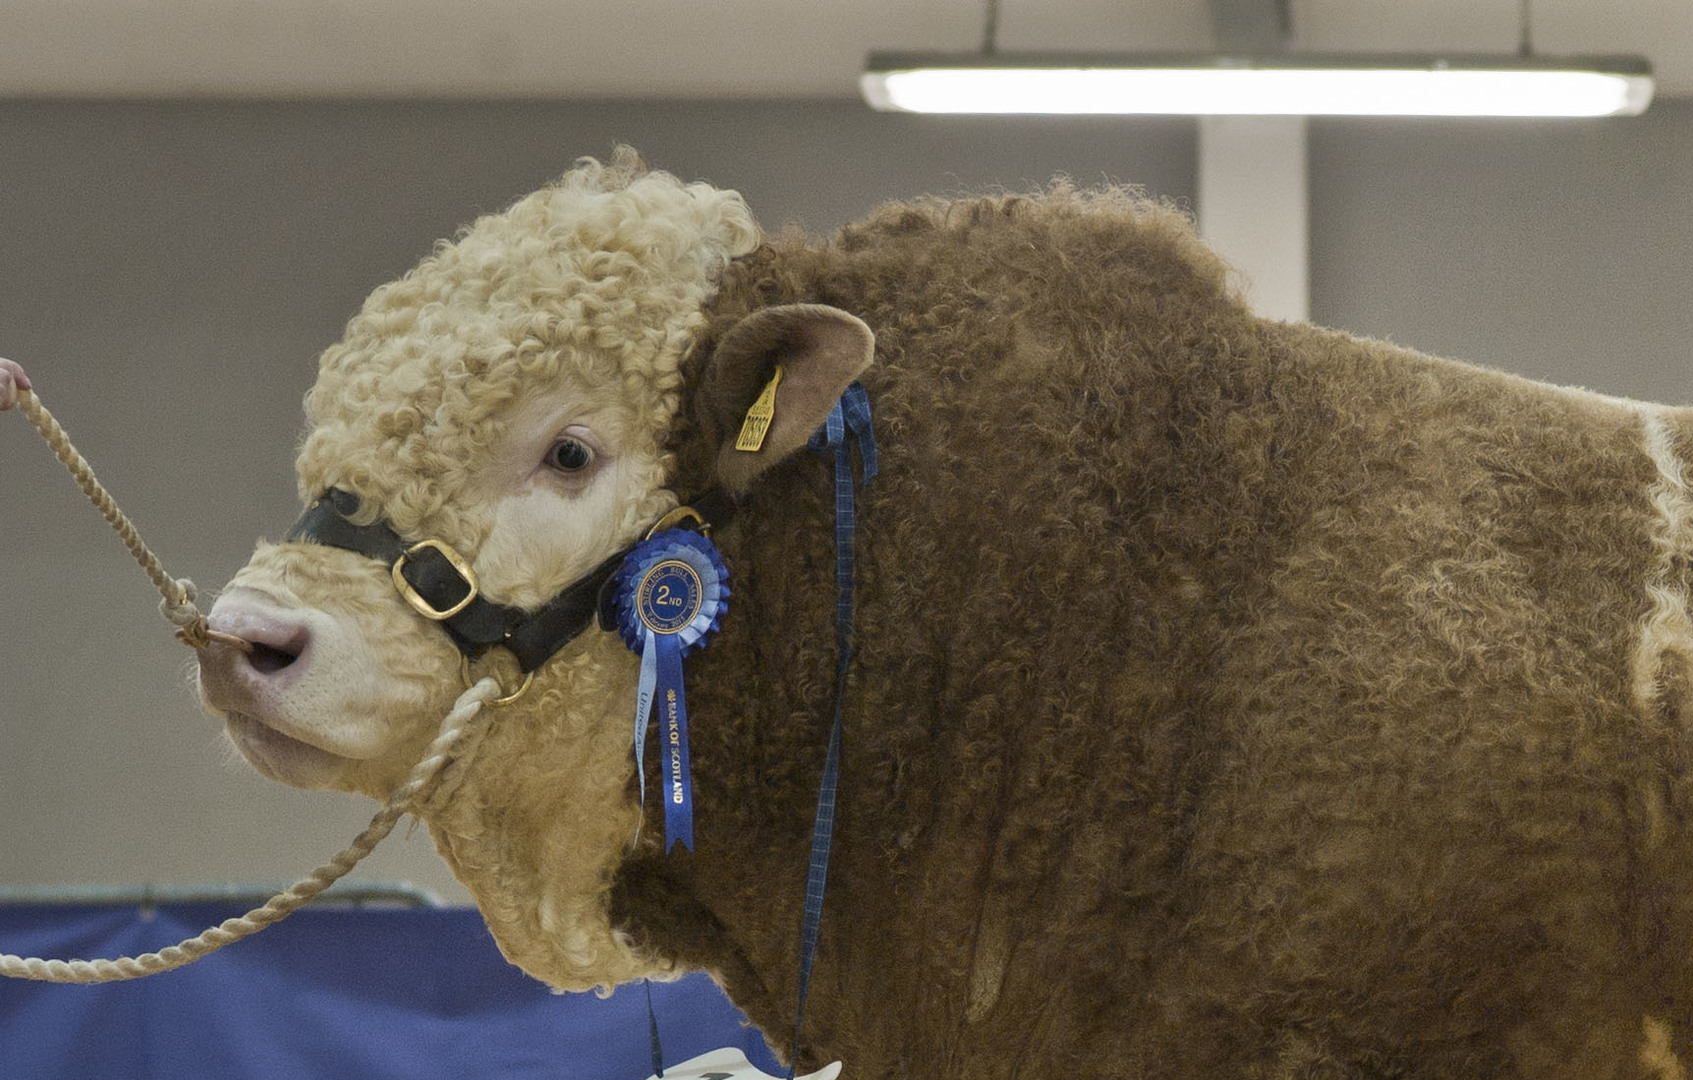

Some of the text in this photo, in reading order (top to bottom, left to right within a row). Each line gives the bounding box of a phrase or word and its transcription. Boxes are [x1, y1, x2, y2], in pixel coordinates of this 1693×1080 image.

[656, 585, 682, 607] 2ND
[668, 702, 683, 804] BANK OF SCOTLAND
